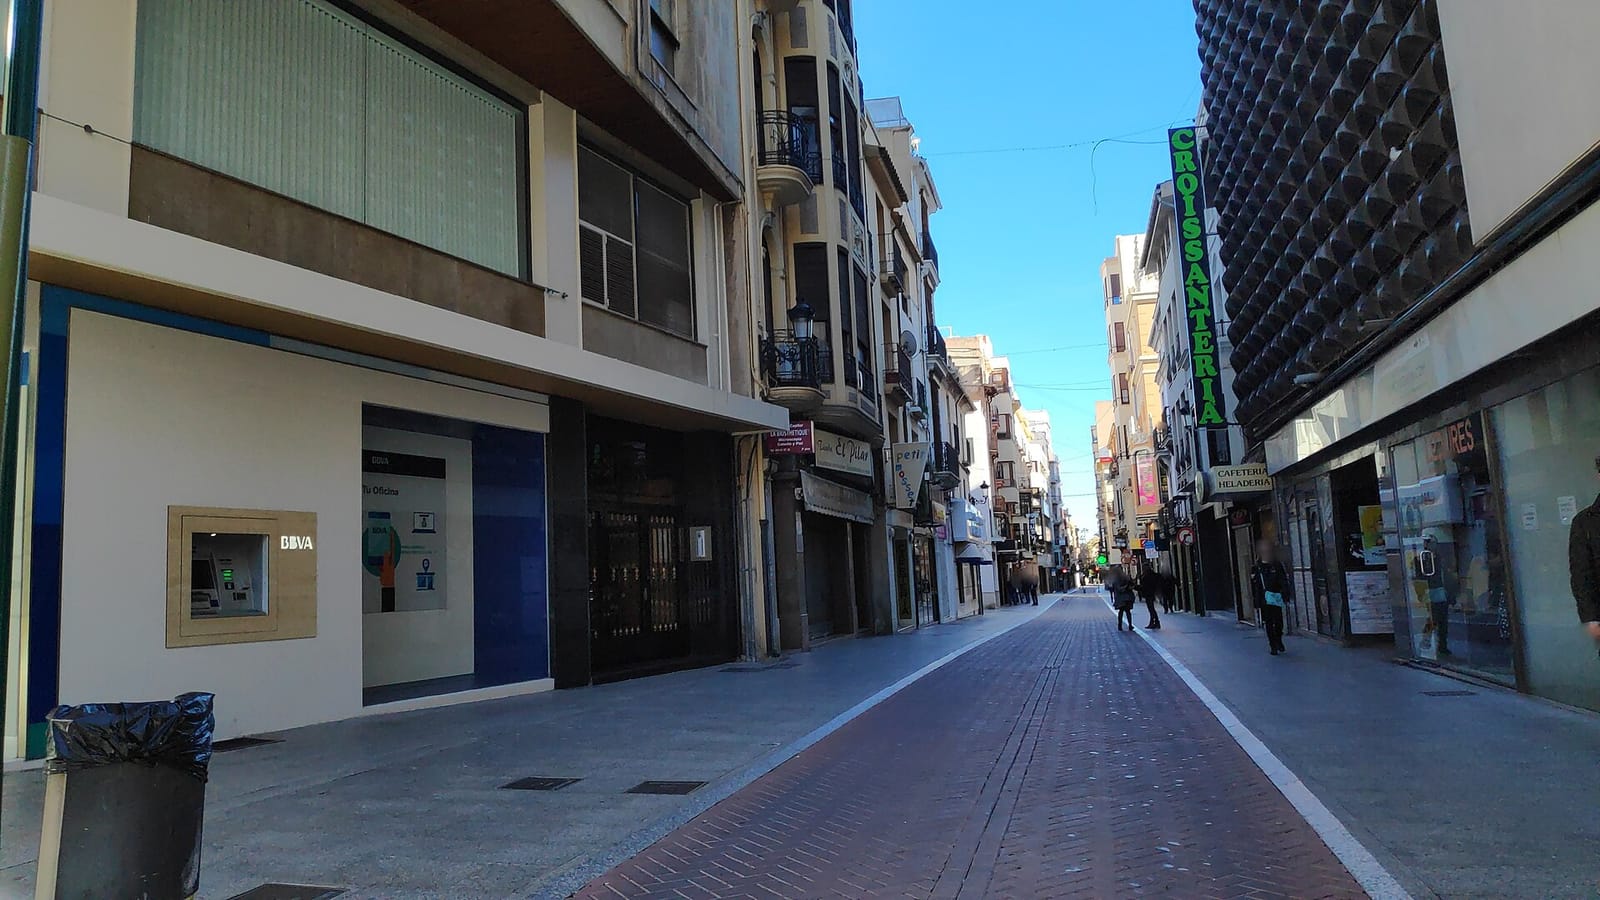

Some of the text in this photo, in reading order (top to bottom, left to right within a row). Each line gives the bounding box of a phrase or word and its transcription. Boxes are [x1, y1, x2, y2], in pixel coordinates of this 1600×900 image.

[1171, 128, 1225, 426] CROISSANTERIA
[835, 438, 846, 458] El
[848, 440, 869, 463] Pilar
[1217, 467, 1269, 478] CAFETERIA
[1218, 478, 1271, 489] HELADERIA
[373, 485, 399, 497] Oficina
[280, 535, 314, 550] BBVA
